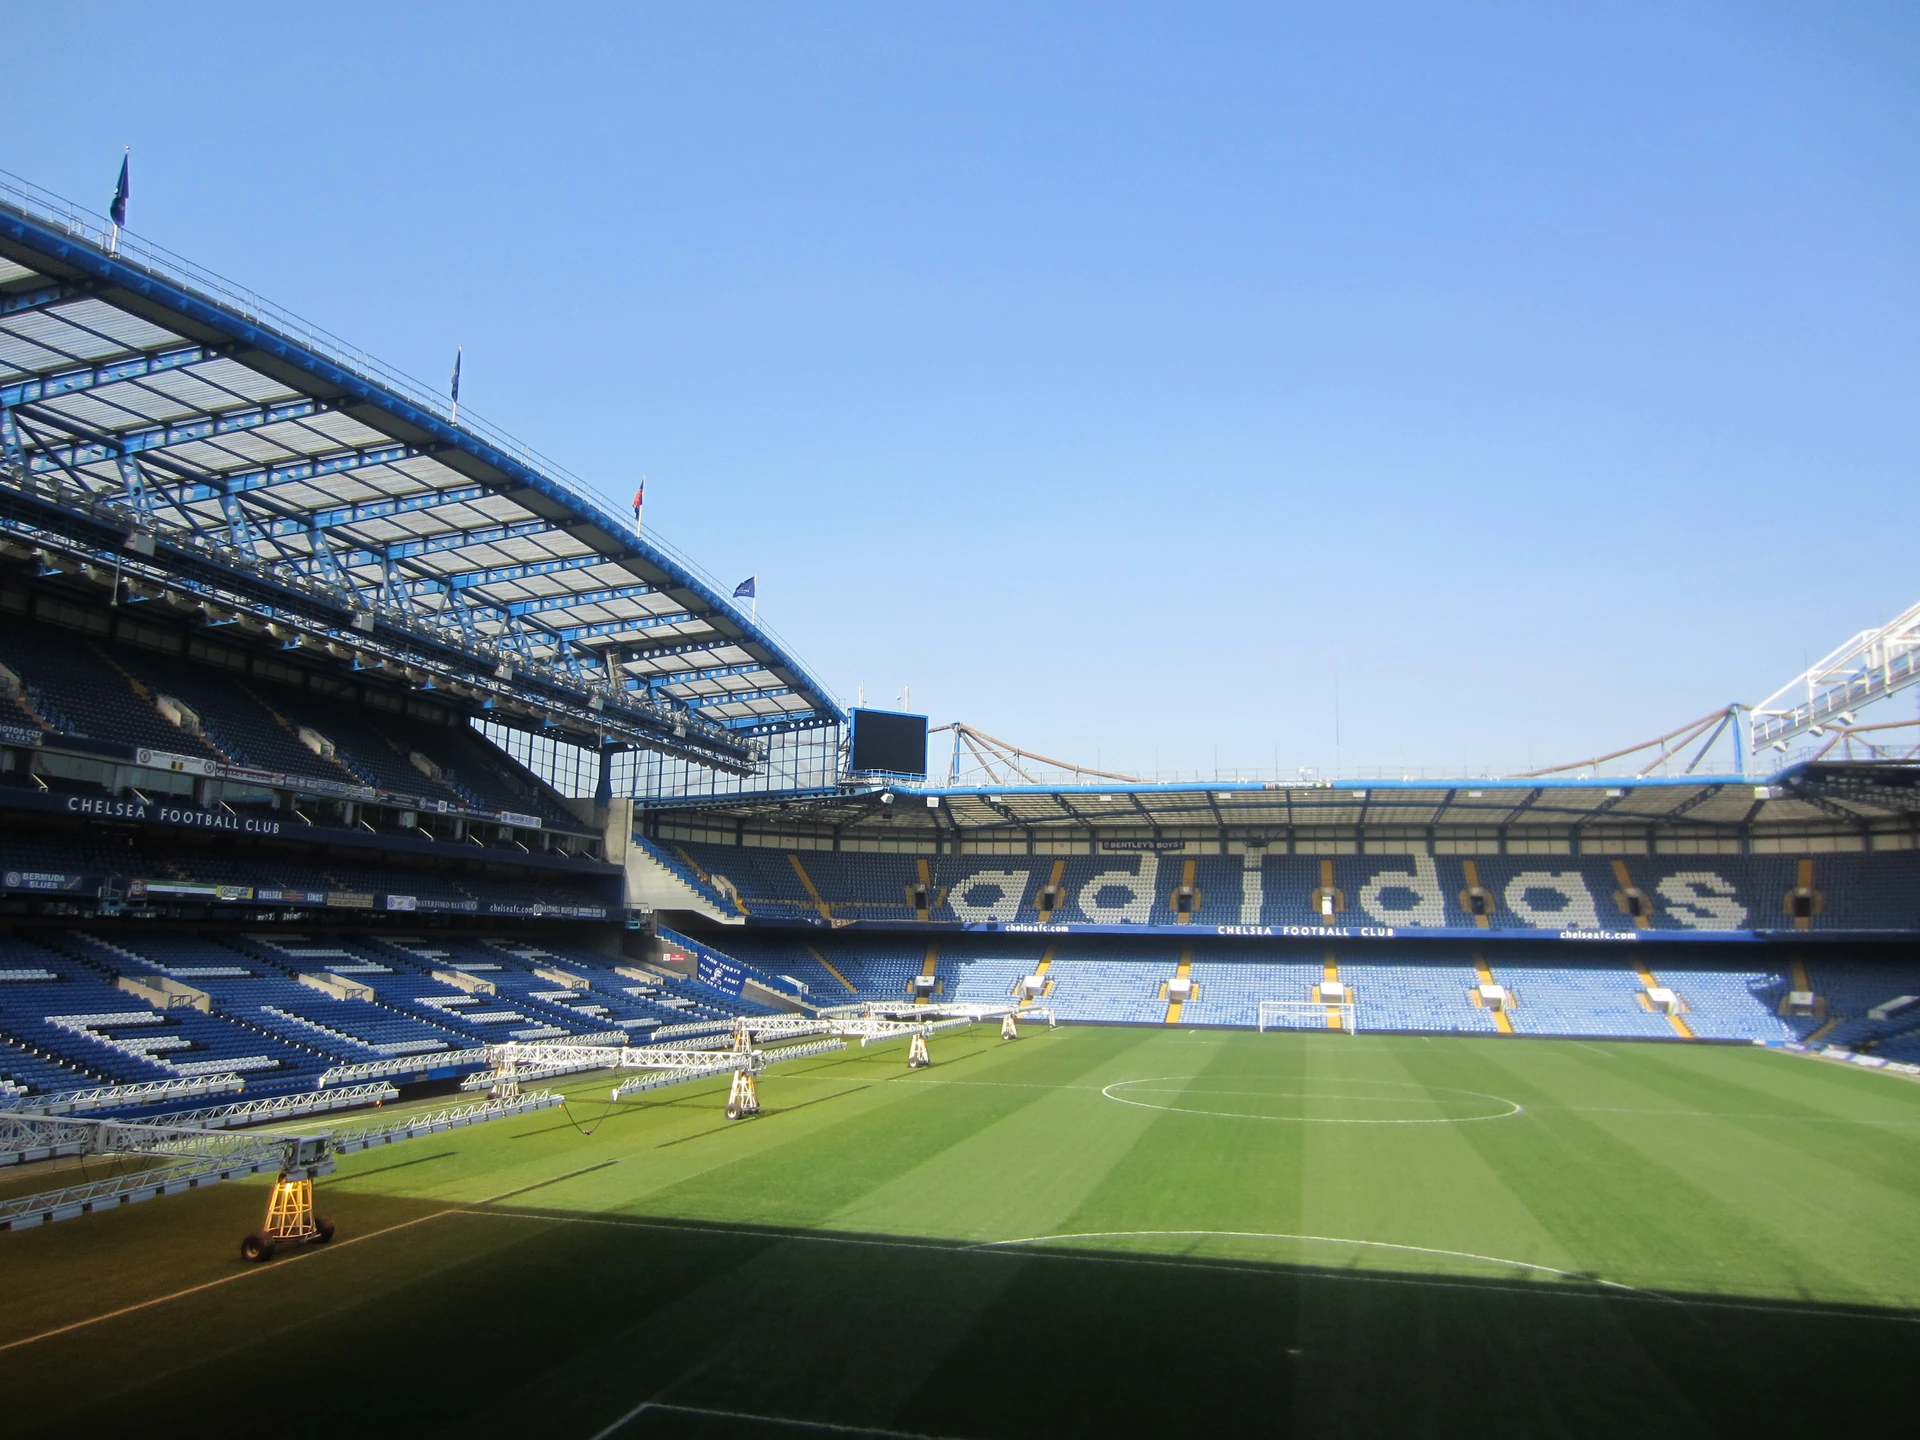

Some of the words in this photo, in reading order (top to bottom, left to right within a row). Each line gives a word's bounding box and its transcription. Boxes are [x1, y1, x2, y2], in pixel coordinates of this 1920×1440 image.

[5, 733, 31, 742] BLUES
[68, 797, 145, 818] CHELSEA
[160, 809, 239, 829] FOOTBALL
[245, 819, 280, 834] CLUB
[1110, 841, 1154, 849] BENTLEY'S
[1157, 841, 1178, 849] BOYS
[22, 872, 65, 882] BERMUDA
[29, 880, 58, 889] BLUES
[258, 890, 282, 900] CHELSEA
[948, 852, 1748, 931] adidas
[490, 903, 533, 914] chelseafc.com
[1005, 924, 1069, 932] chelseafc.com
[1217, 926, 1272, 935] CHELSEA
[1283, 927, 1349, 936] FOOTBALL
[1360, 927, 1394, 937] CLUB
[1560, 930, 1636, 939] chelseafc.com
[703, 954, 718, 966] JOHN
[700, 963, 713, 975] BLUE
[723, 976, 740, 986] ARMY
[719, 986, 737, 996] LOYAL
